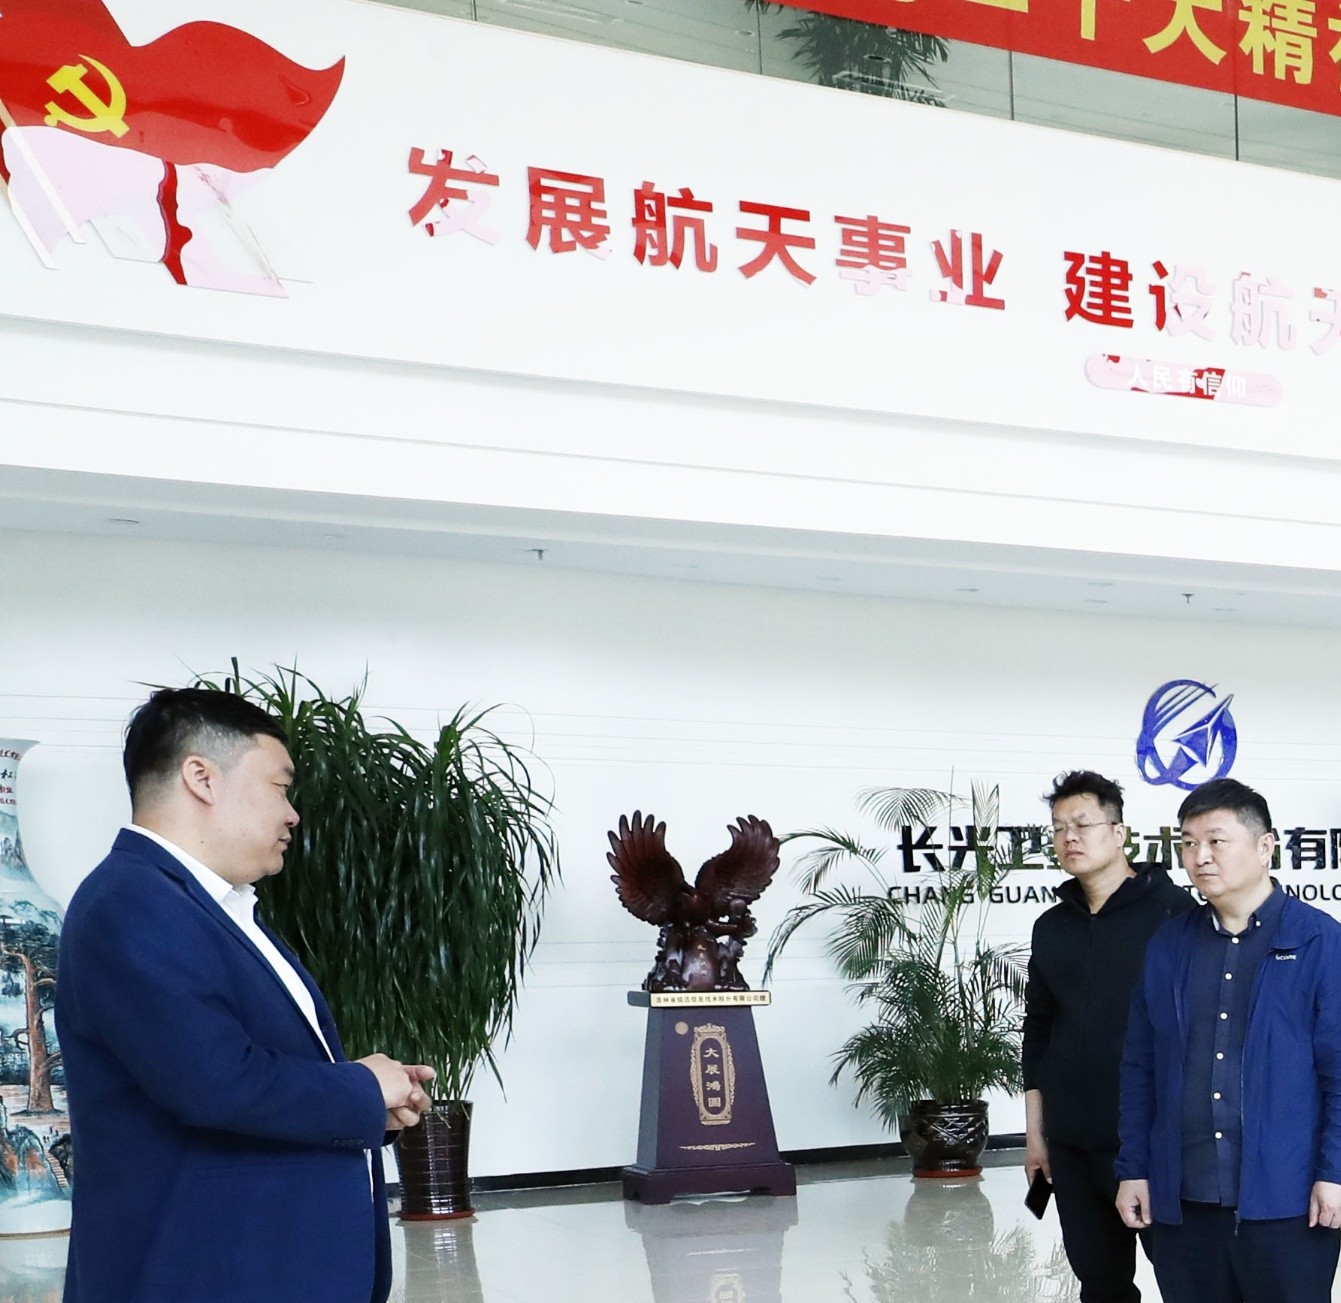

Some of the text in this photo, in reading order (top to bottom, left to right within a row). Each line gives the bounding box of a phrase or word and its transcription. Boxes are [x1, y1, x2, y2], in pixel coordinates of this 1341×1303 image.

[407, 146, 1006, 312] 发展航天事业
